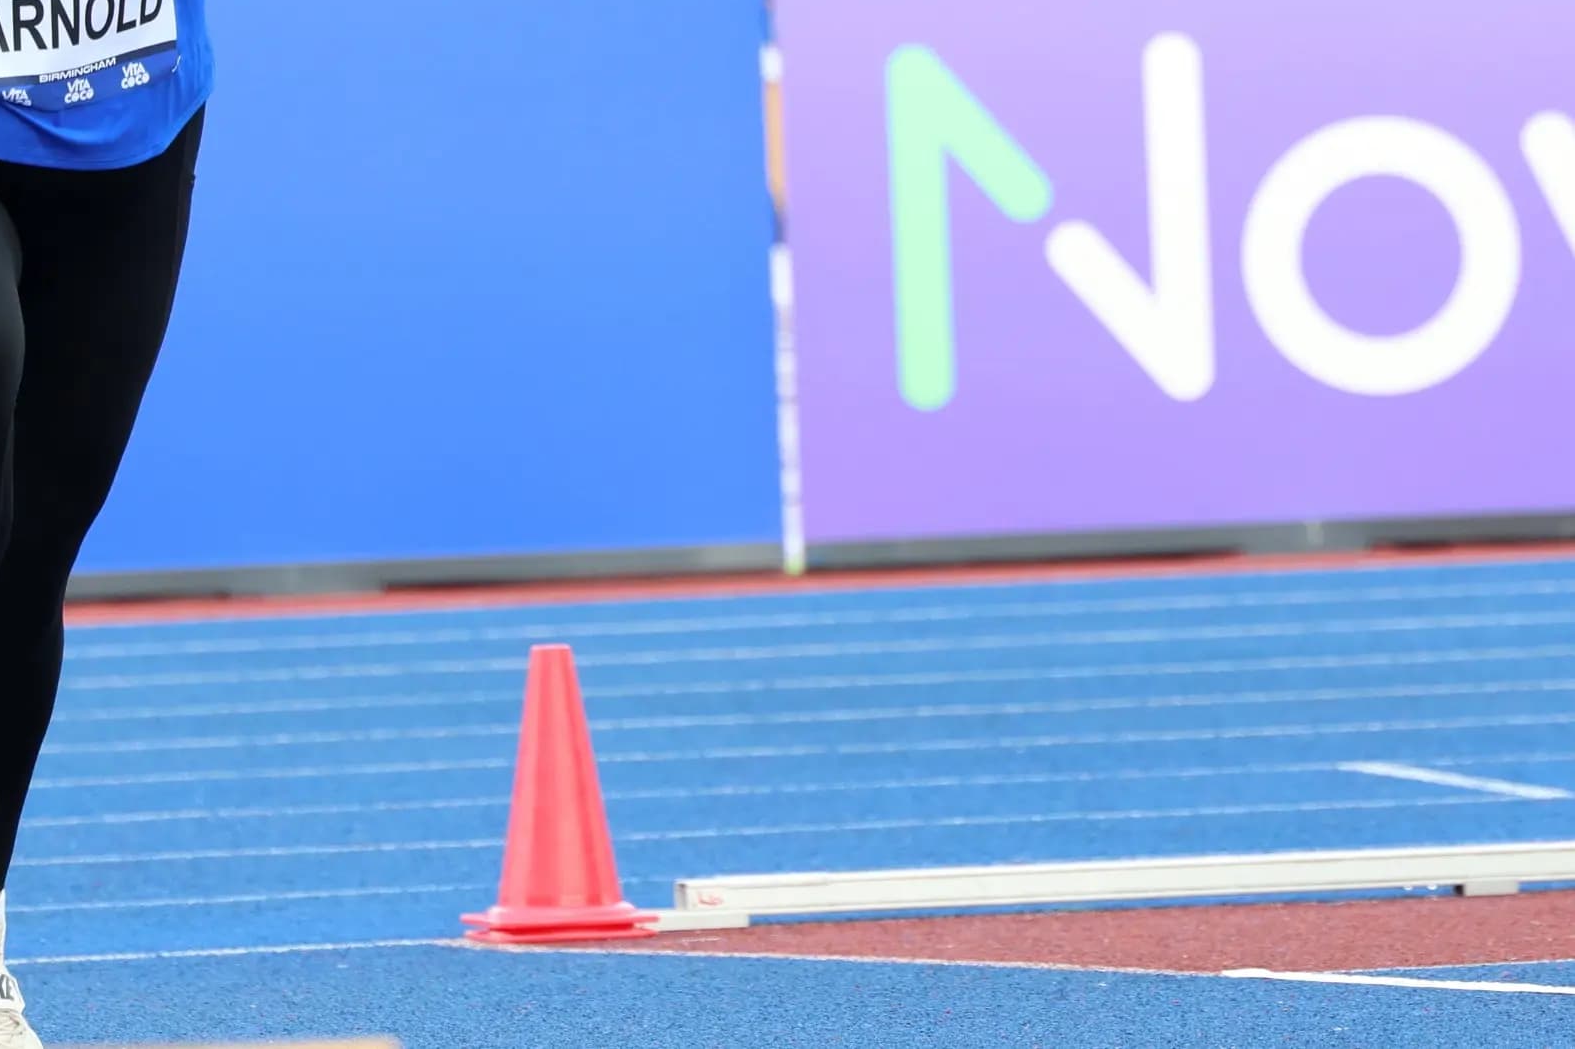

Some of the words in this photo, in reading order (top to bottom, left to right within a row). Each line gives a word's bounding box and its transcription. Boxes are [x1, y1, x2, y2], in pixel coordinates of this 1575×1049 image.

[38, 57, 117, 84] BIRMINGHAM
[121, 61, 147, 80] VITA
[66, 76, 92, 94] VITA
[120, 72, 151, 89] COCO
[64, 86, 95, 104] COCO
[886, 31, 1575, 412] No
